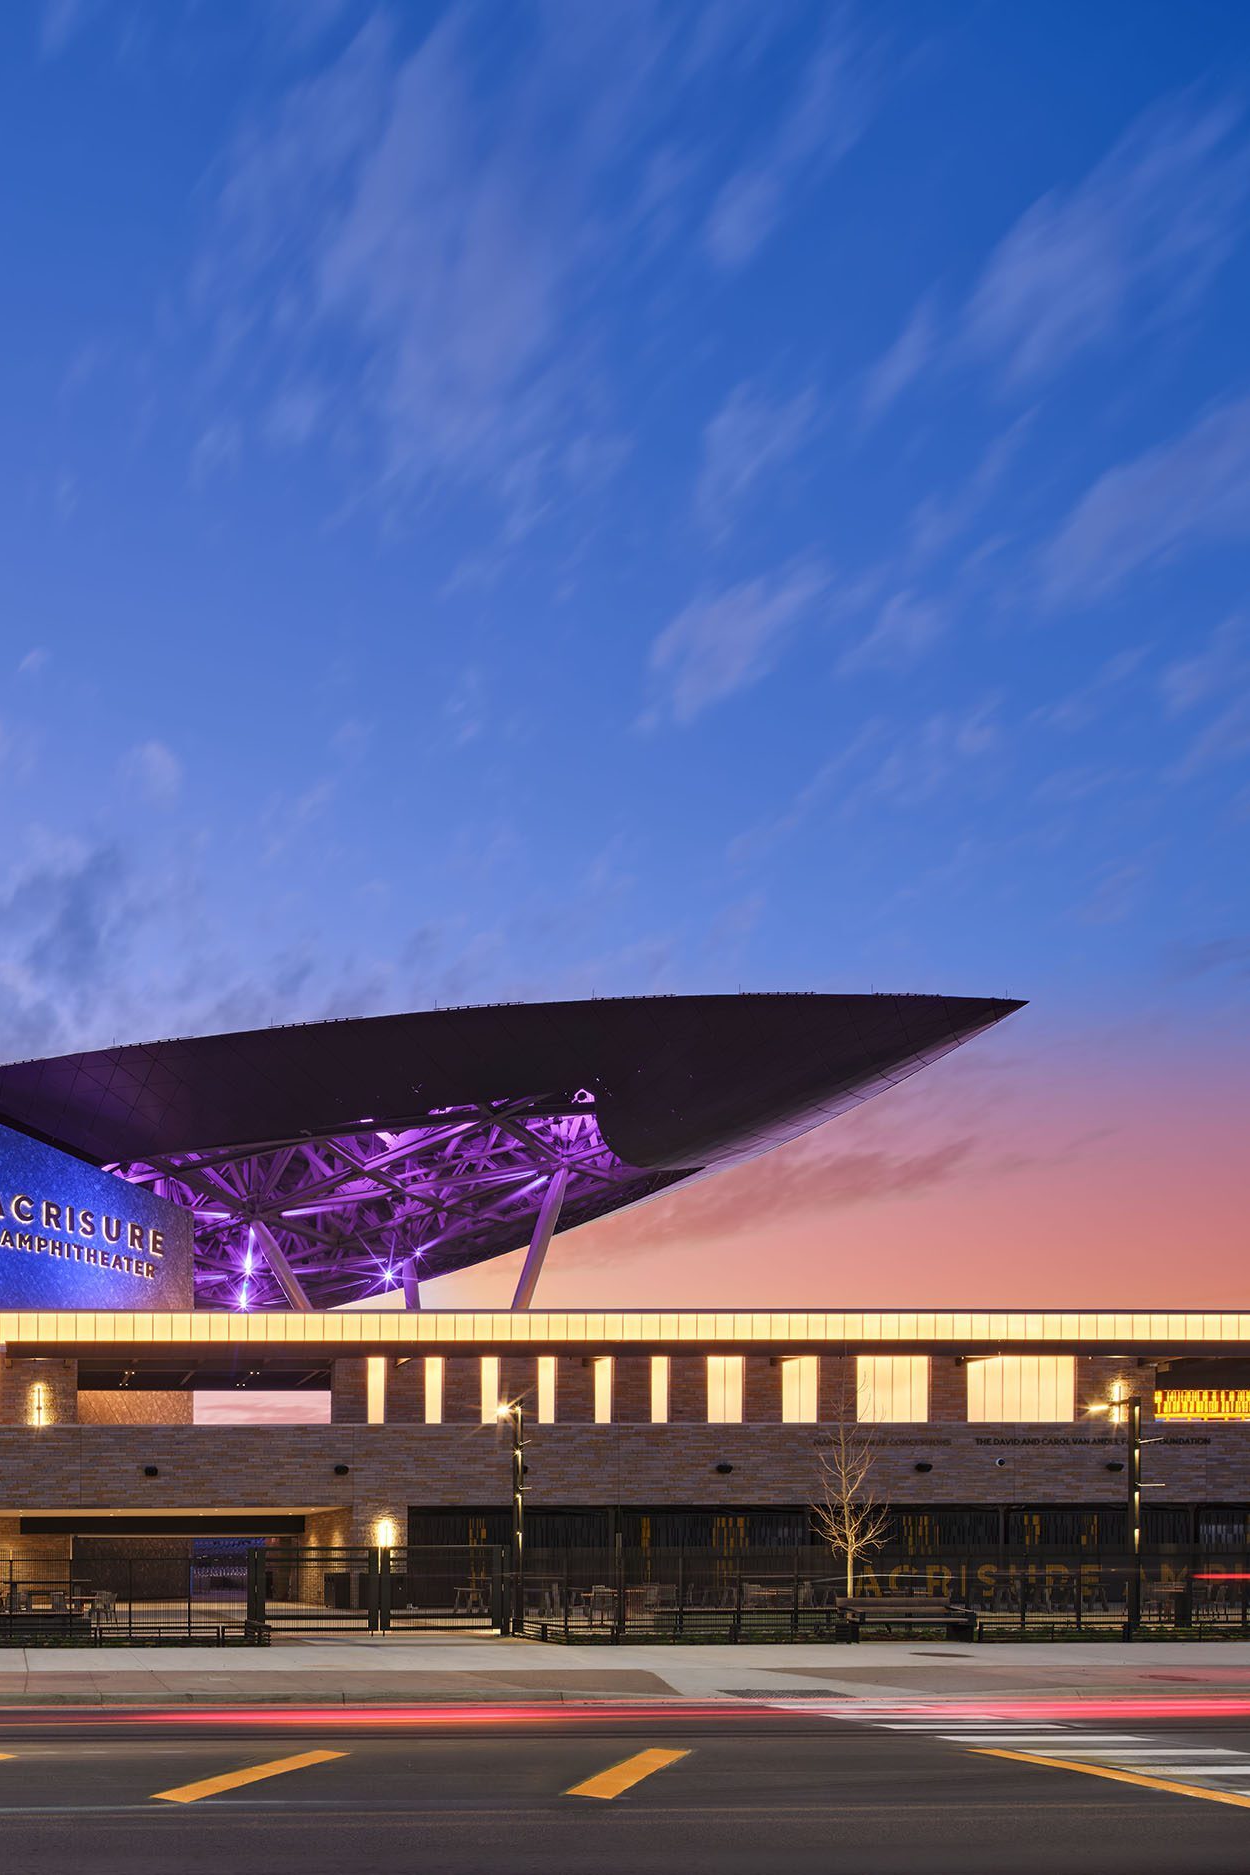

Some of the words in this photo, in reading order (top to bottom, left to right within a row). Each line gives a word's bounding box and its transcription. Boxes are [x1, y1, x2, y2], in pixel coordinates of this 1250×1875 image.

[0, 1229, 157, 1279] AMPHITHEATER
[975, 1438, 993, 1446] THE
[994, 1438, 1020, 1446] DAVID
[1021, 1438, 1040, 1446] AND
[1041, 1438, 1070, 1446] CAROL
[1072, 1438, 1090, 1446] VAN
